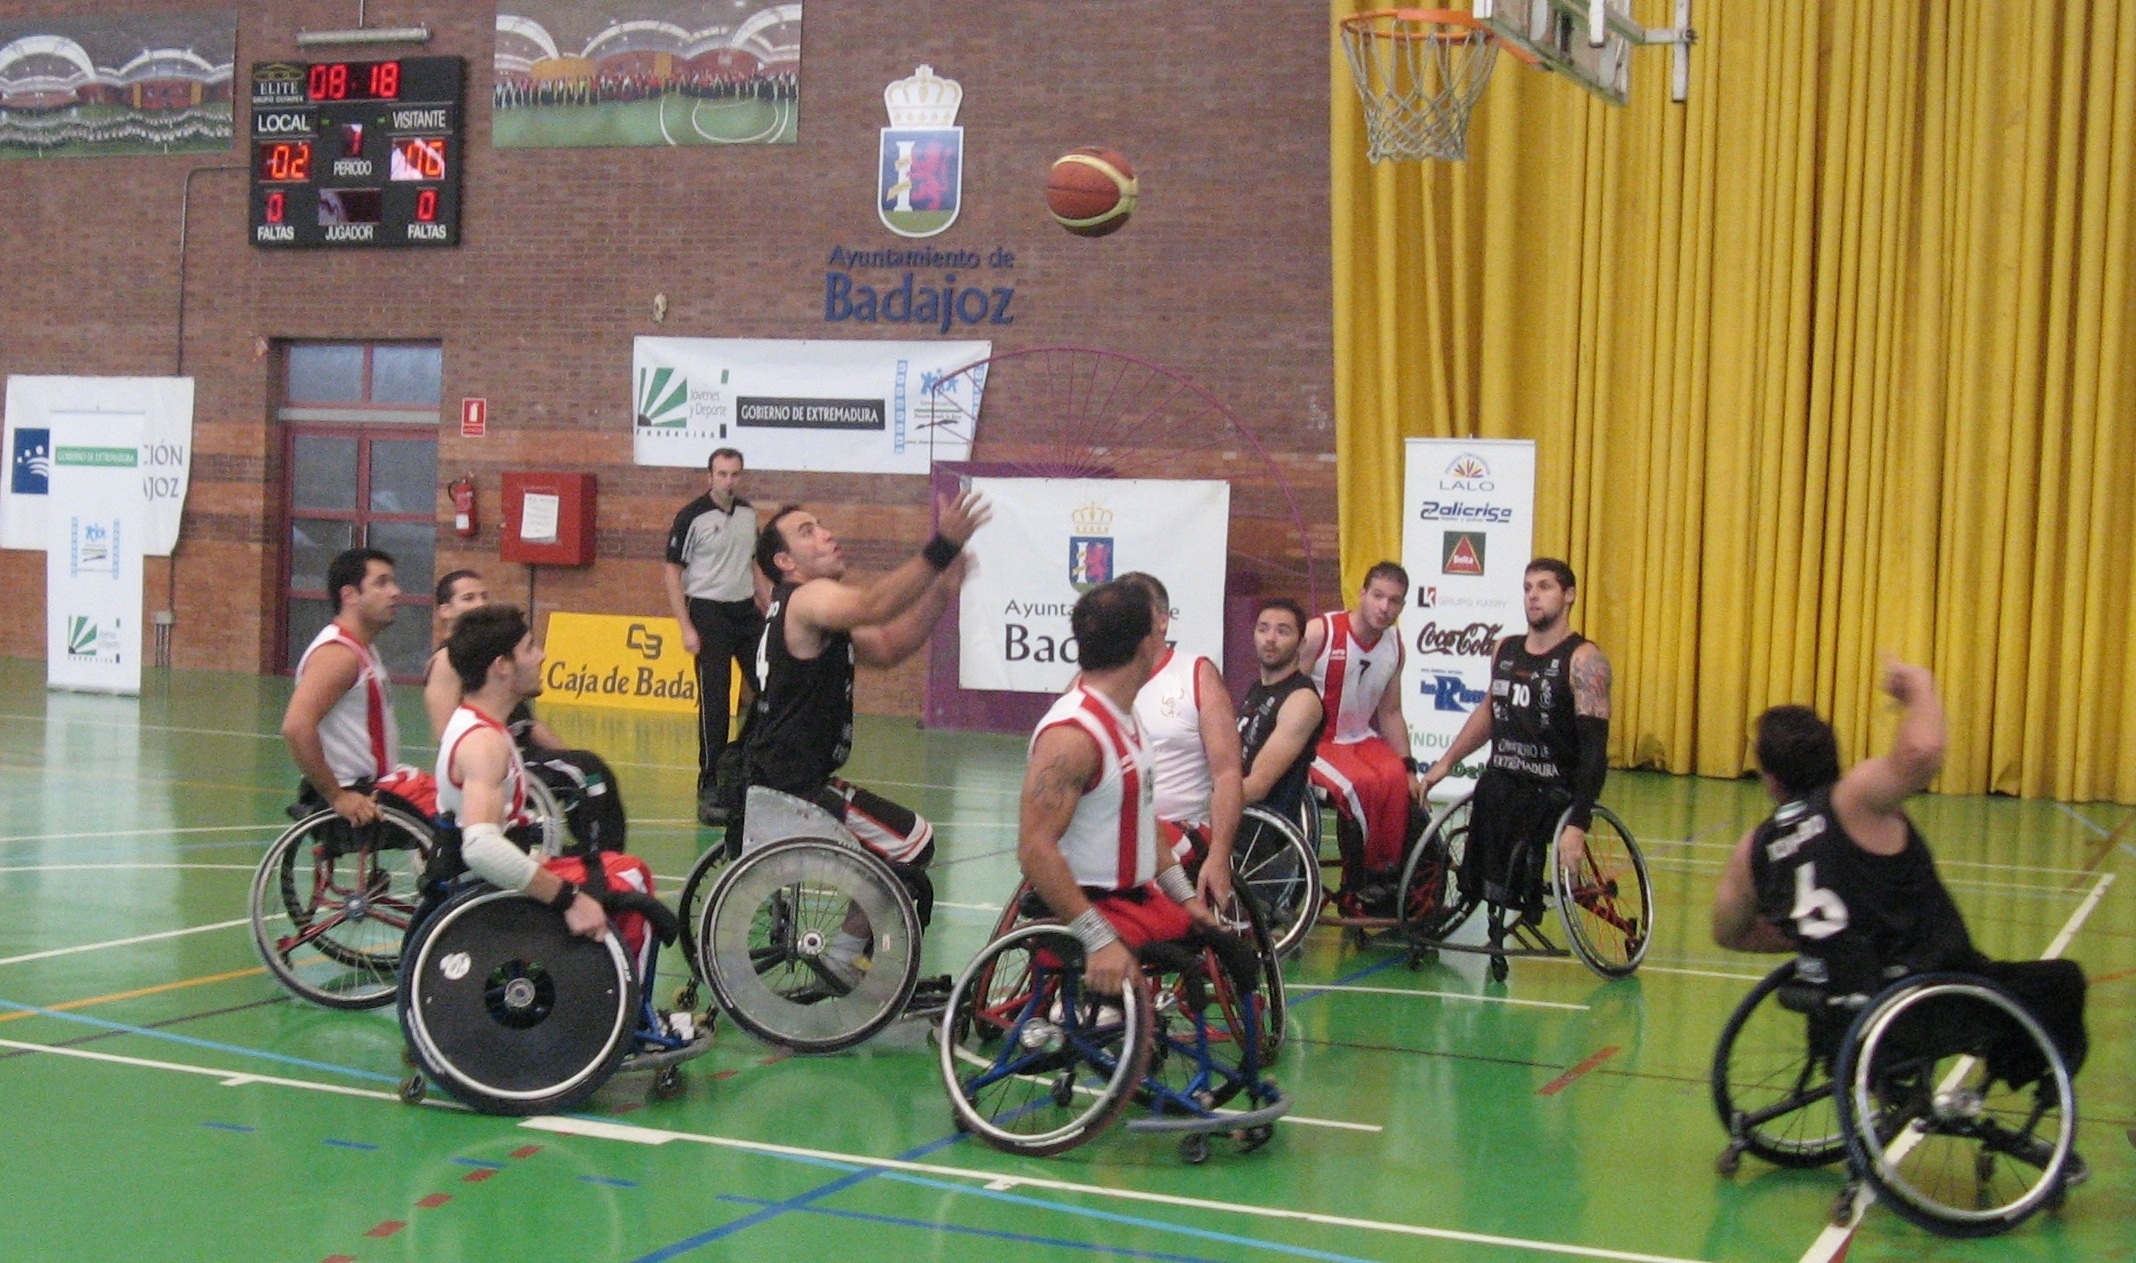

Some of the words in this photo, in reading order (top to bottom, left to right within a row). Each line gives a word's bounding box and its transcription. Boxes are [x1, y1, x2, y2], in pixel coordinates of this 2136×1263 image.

[260, 81, 299, 95] ELITE
[257, 113, 311, 133] LOCAL
[392, 109, 447, 129] VISITANTE
[333, 160, 373, 177] PERIODO
[266, 191, 286, 223] 0
[417, 189, 438, 222] 0
[257, 225, 295, 241] FALTAS
[325, 225, 374, 241] JUGADOR
[407, 223, 447, 239] FALTAS
[827, 245, 981, 269] Ayuntamiento
[988, 245, 1015, 268] de
[824, 271, 1015, 335] Badajoz
[740, 404, 791, 421] GOBIERNO
[792, 406, 804, 421] DE
[806, 406, 880, 423] EXTREMADURA
[1439, 480, 1495, 492] LALO
[1359, 658, 1372, 686] 7
[547, 661, 598, 699] Caja
[602, 665, 630, 695] de
[633, 666, 701, 707] Bada
[1511, 682, 1531, 708] 10
